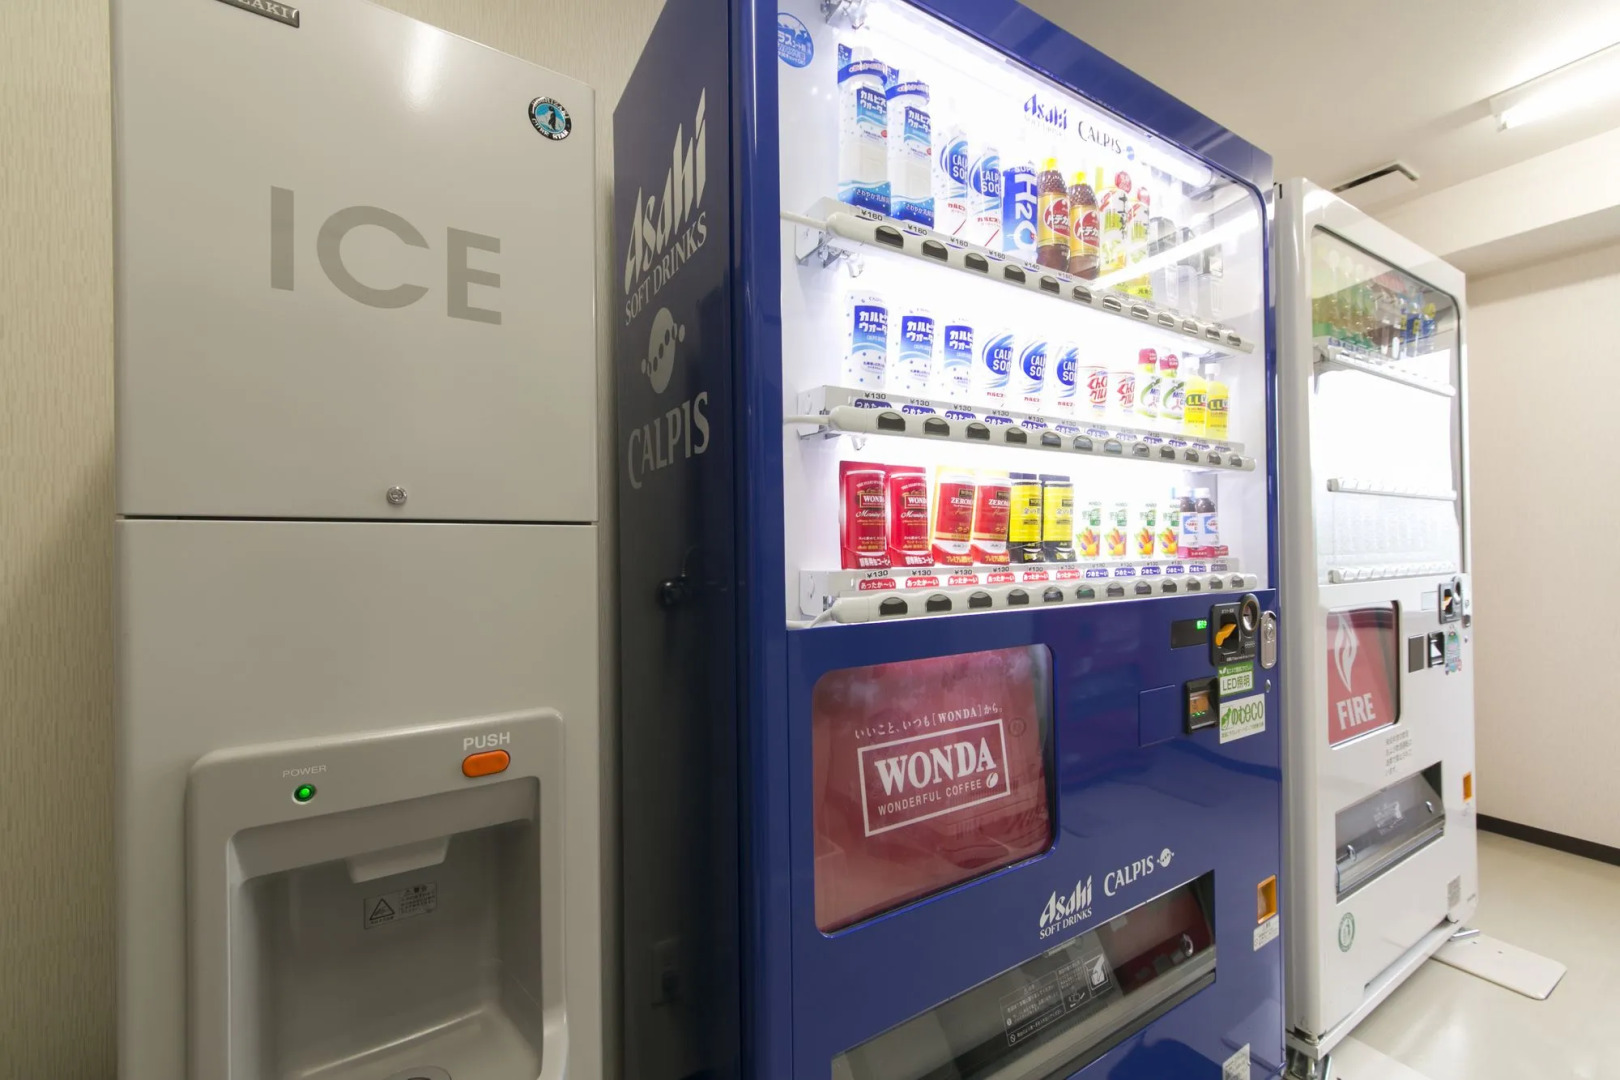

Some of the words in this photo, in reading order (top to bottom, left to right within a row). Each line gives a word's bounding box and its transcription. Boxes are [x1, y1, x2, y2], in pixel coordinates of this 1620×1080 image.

[1078, 120, 1122, 154] CALPIS
[624, 86, 707, 296] Asahi
[270, 185, 502, 325] ICE
[625, 274, 652, 327] SOFT
[653, 210, 708, 294] DRINKS
[864, 391, 887, 401] ¥130
[910, 398, 930, 407] ¥130
[953, 403, 972, 412] ¥130
[992, 410, 1010, 418] ¥130
[1028, 415, 1044, 423] ¥130
[626, 390, 711, 491] CALPIS
[866, 569, 888, 579] ¥130
[1336, 692, 1377, 731] FIRE
[463, 731, 511, 750] PUSH
[282, 764, 327, 778] POWER
[874, 736, 997, 797] WONDA
[877, 789, 942, 816] WONDERFUL
[945, 778, 982, 798] COFFEE
[1103, 855, 1155, 897] CALPIS
[1039, 874, 1093, 928] Asahi
[1039, 920, 1062, 940] SOFT
[1062, 907, 1093, 929] DRINKS
